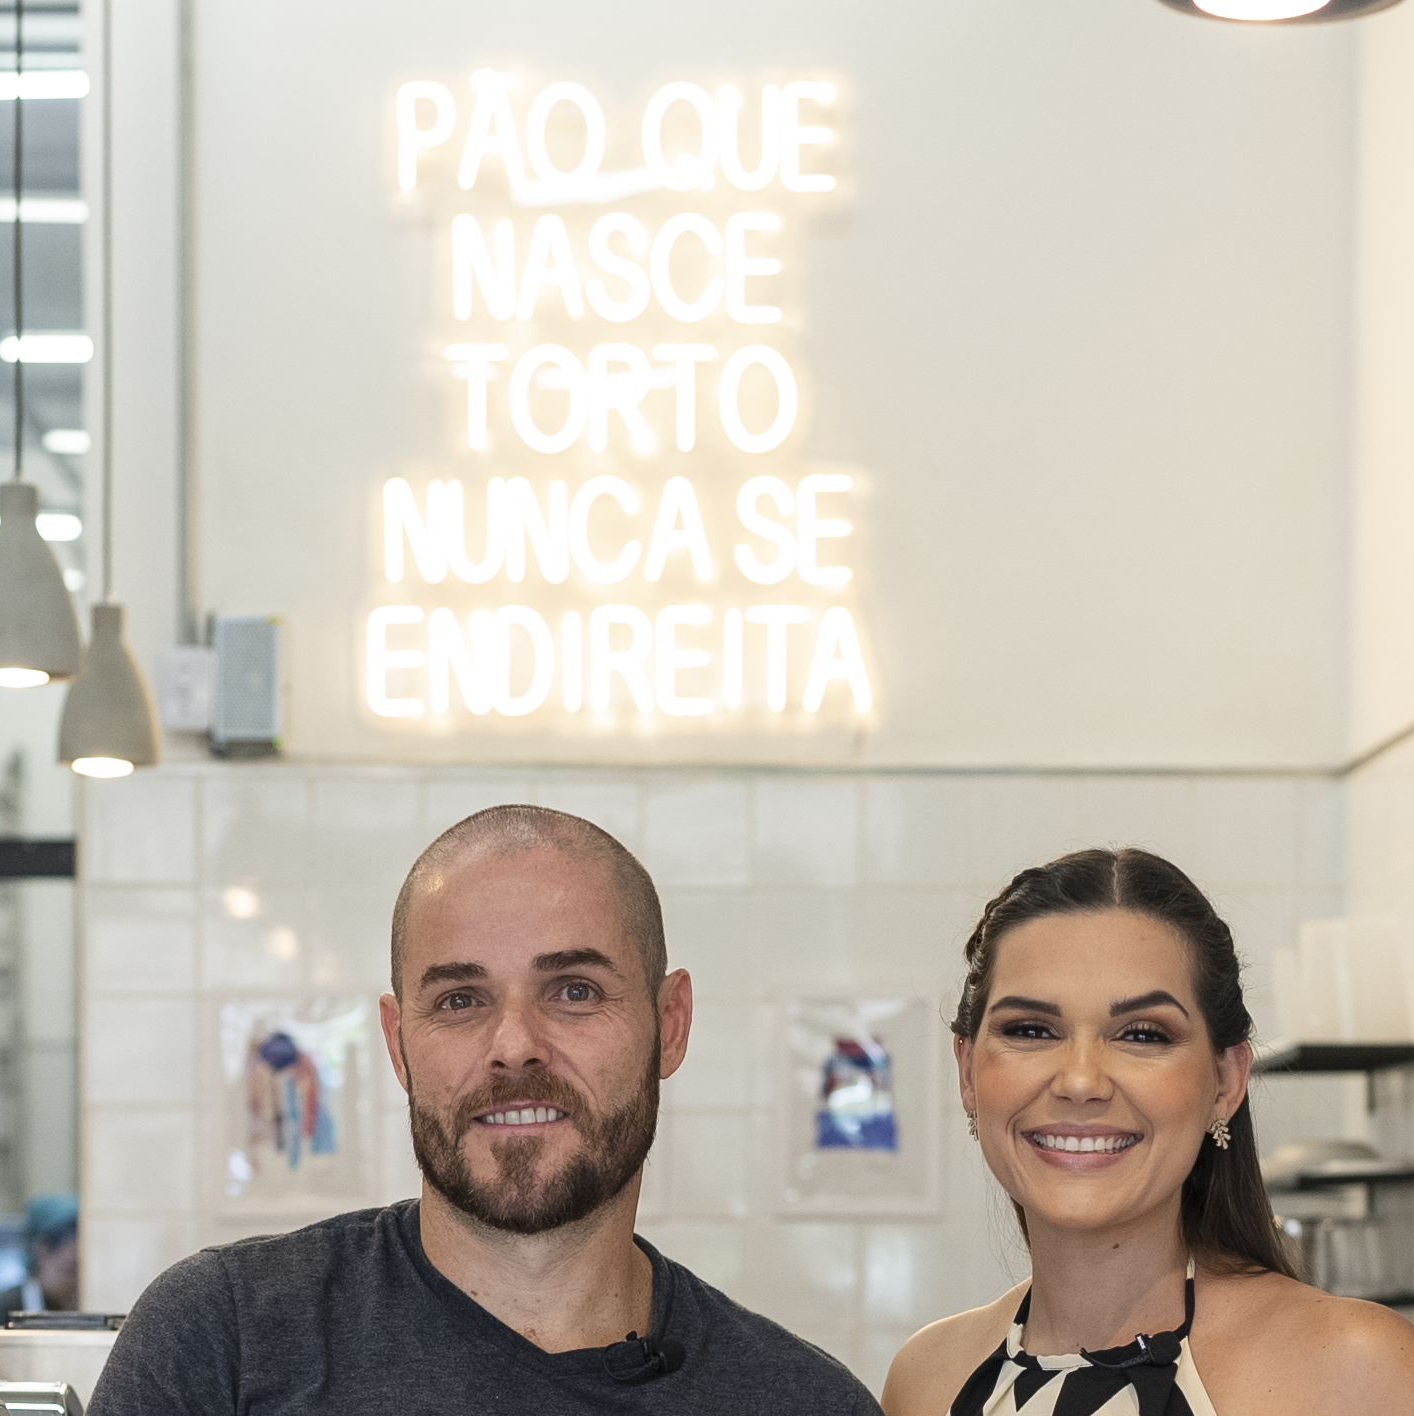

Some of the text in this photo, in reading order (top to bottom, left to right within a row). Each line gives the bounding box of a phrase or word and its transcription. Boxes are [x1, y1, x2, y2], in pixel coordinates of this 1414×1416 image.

[641, 80, 838, 192] QUE
[450, 211, 784, 324] NASCE
[443, 341, 799, 455] TORTO
[383, 473, 854, 586] NUNCA SE
[365, 603, 874, 718] ENDIREITA
